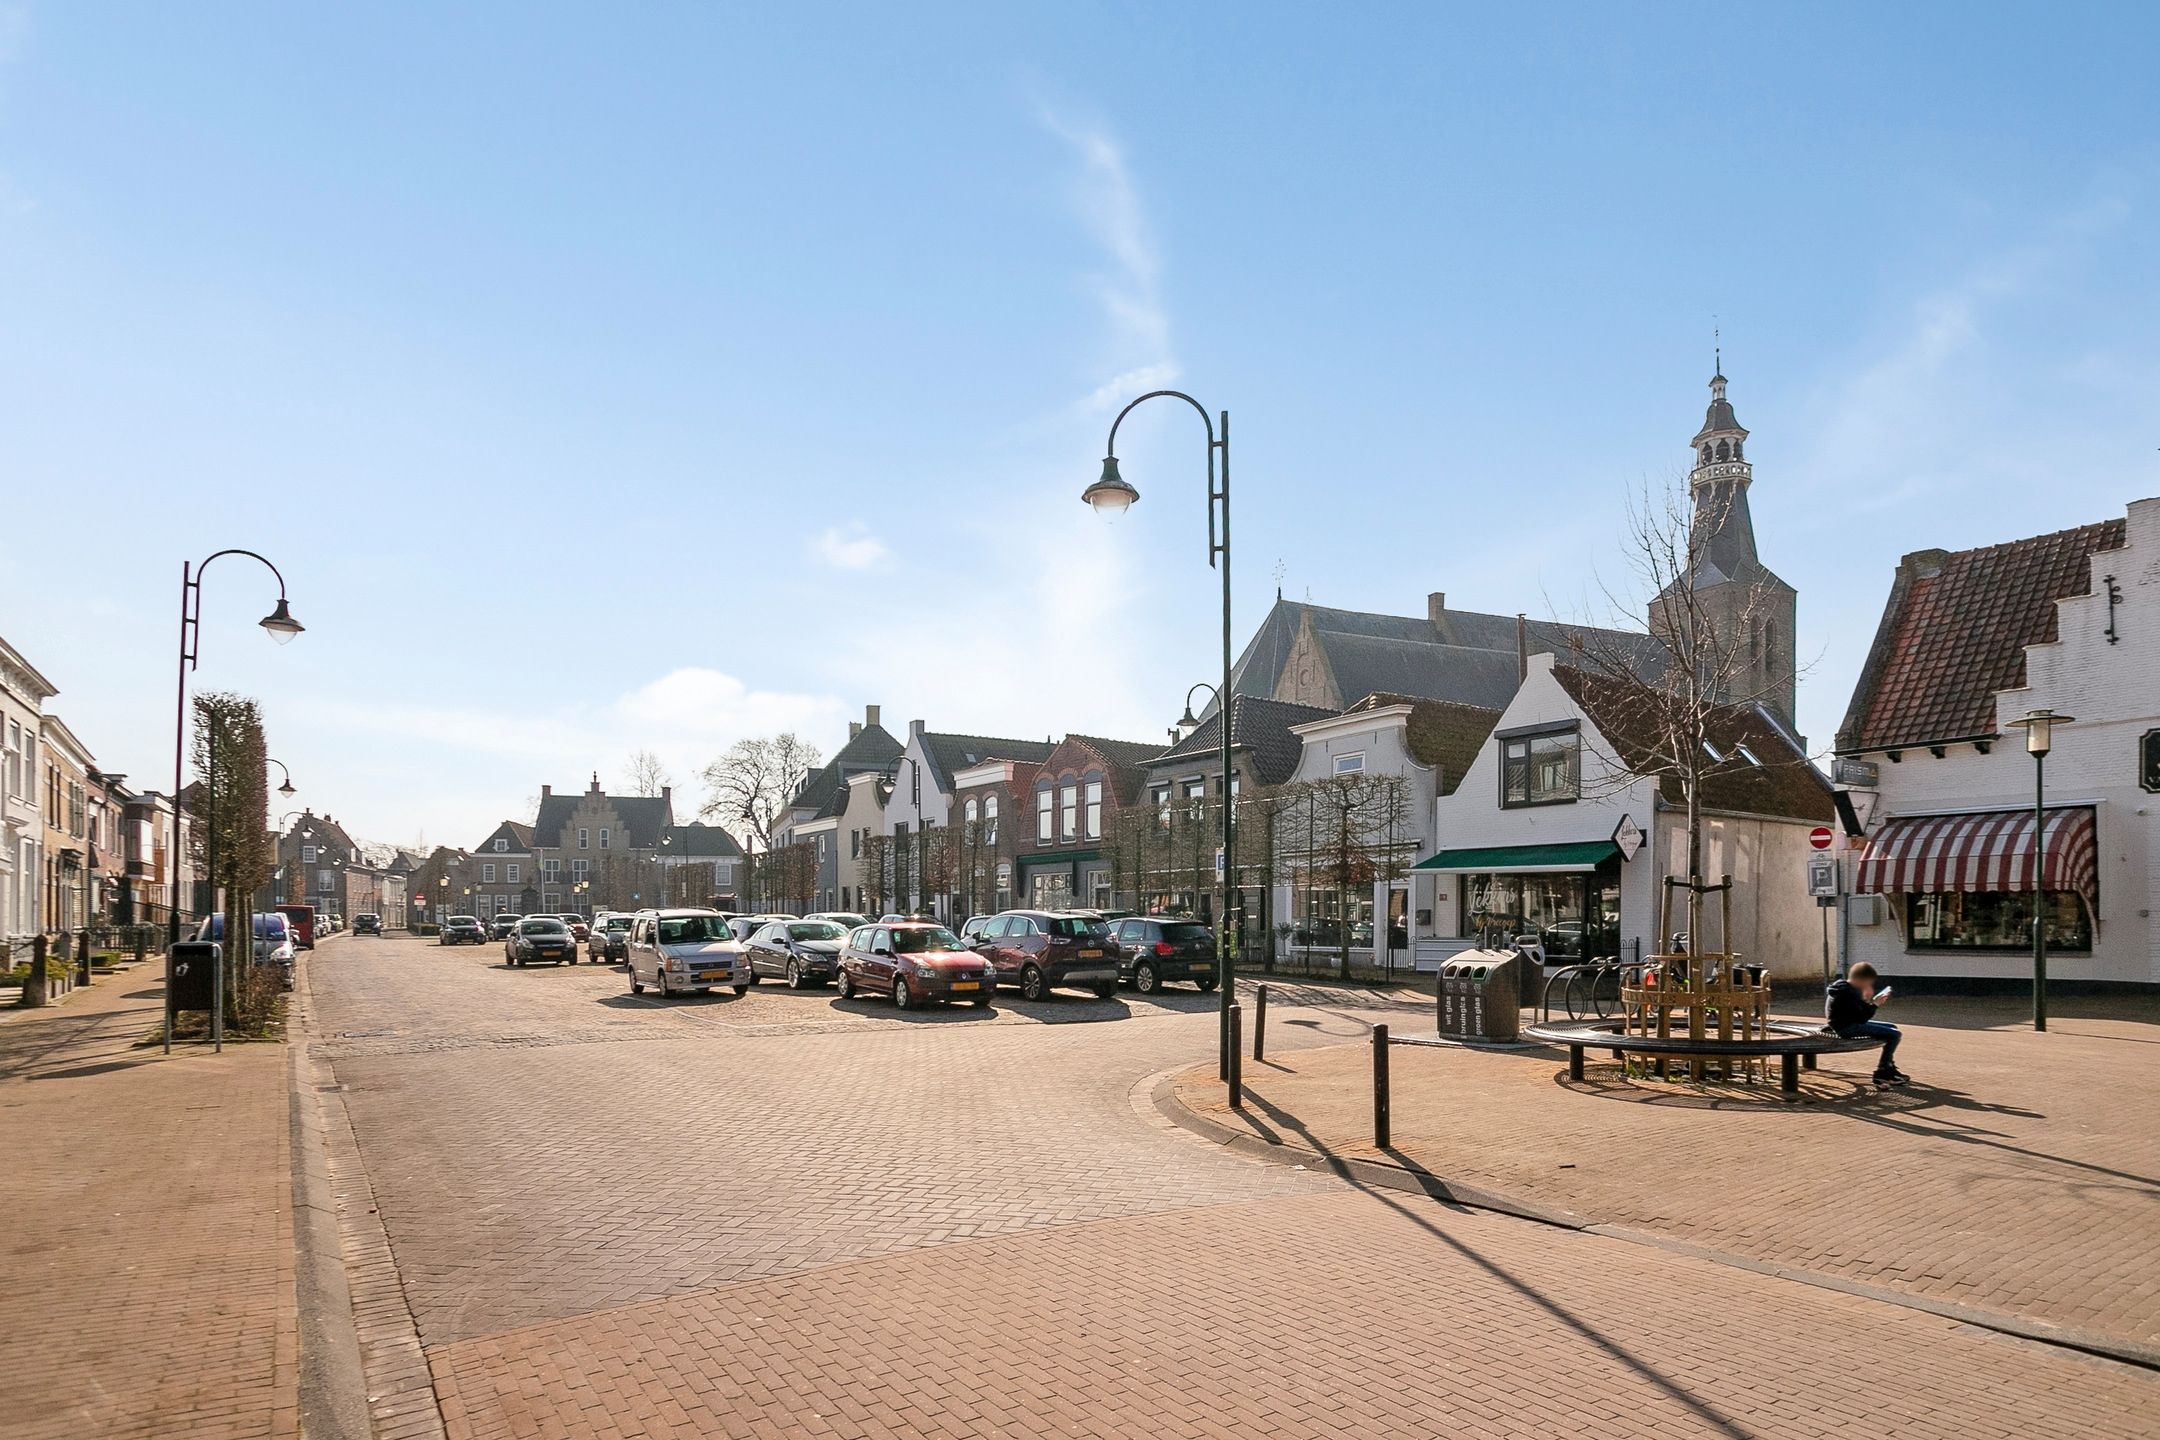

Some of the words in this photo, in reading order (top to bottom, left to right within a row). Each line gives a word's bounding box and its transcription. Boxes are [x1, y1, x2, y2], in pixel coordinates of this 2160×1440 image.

[1816, 869, 1828, 885] P
[1445, 995, 1453, 1013] glas
[1474, 996, 1482, 1015] glas
[1475, 1015, 1483, 1036] groen
